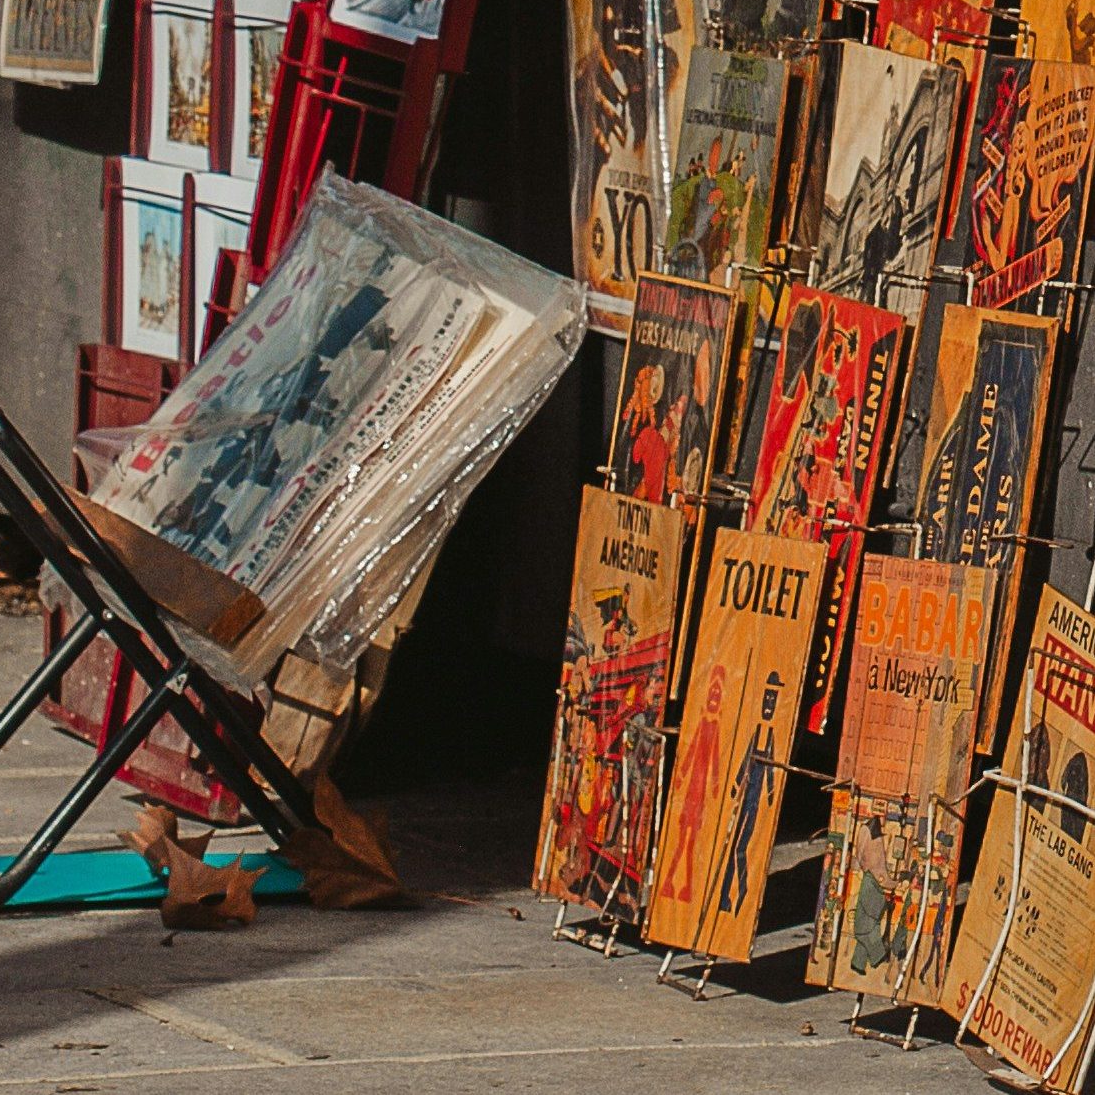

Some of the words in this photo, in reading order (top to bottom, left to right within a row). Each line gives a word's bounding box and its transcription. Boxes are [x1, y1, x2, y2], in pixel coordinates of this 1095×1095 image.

[1036, 92, 1066, 121] VICIOUS
[1067, 85, 1094, 104] RACKET
[1044, 74, 1050, 93] A
[1034, 120, 1052, 141] WITH
[1035, 134, 1066, 161] AROUND
[636, 320, 660, 347] VERS
[661, 325, 673, 350] LA
[674, 328, 700, 356] LUNE
[855, 350, 889, 471] TINTIN
[966, 383, 999, 518] DAME
[617, 499, 652, 537] TINTIN
[719, 557, 810, 621] TOILET
[860, 580, 984, 665] BABAR
[1048, 600, 1095, 657] AMERI
[868, 656, 879, 691] à
[883, 658, 921, 699] New
[922, 665, 961, 704] York
[1028, 814, 1048, 844] THE
[1047, 831, 1067, 858] LAB
[1067, 847, 1094, 880] GANG
